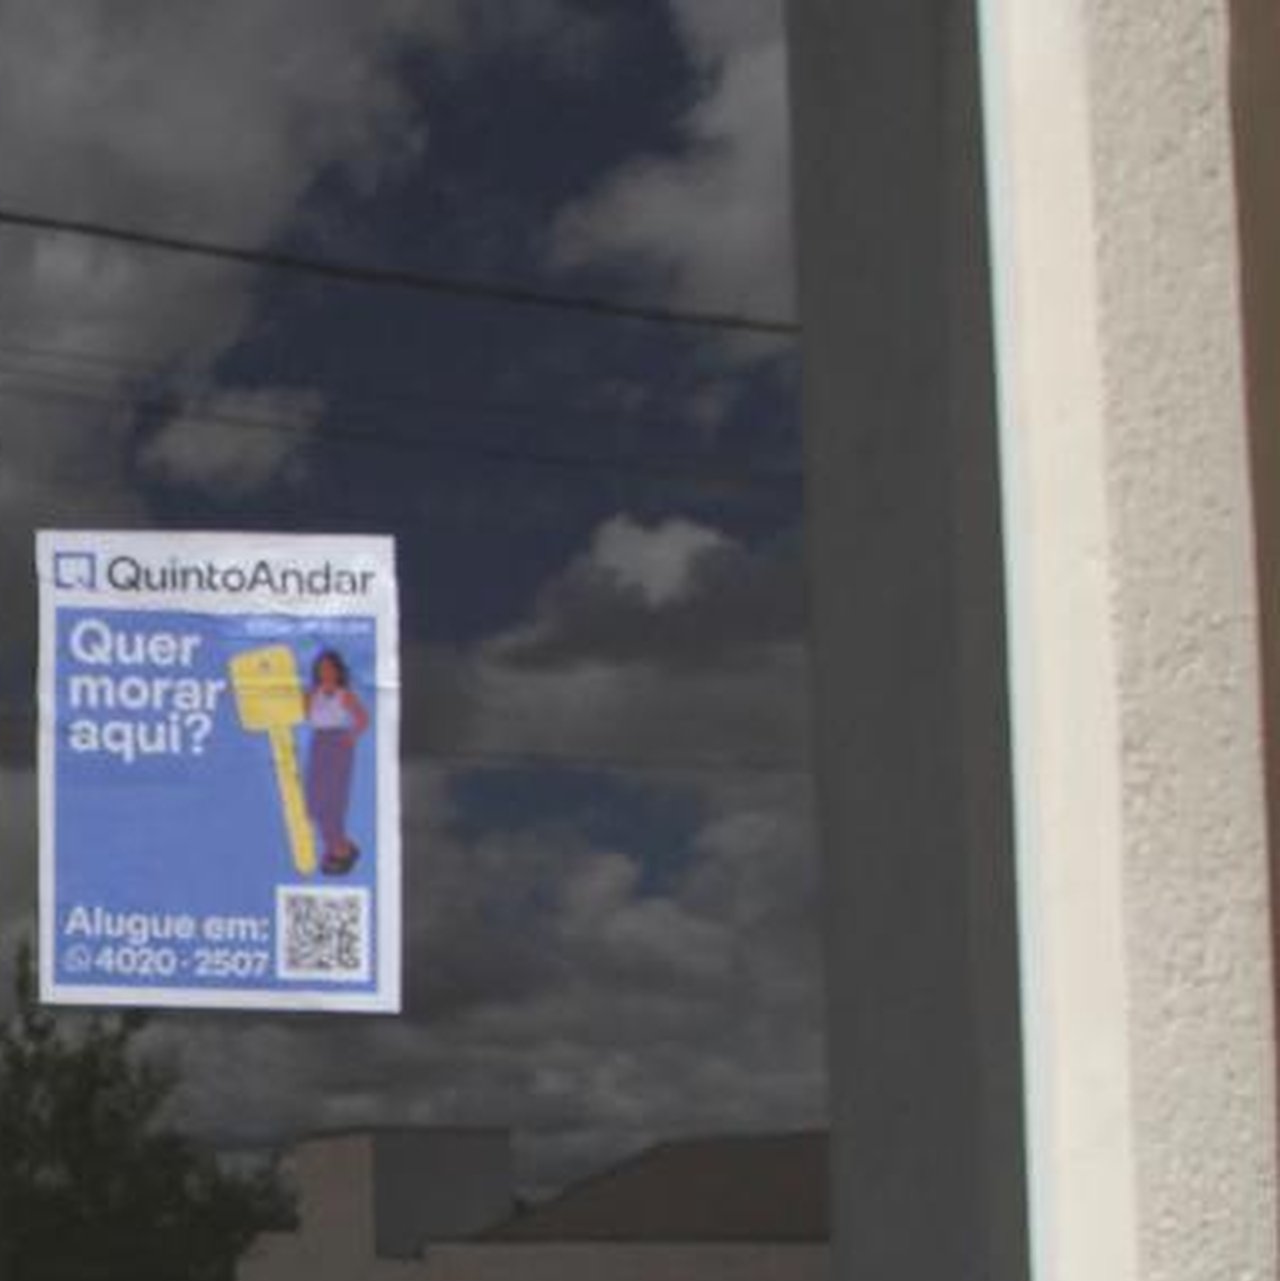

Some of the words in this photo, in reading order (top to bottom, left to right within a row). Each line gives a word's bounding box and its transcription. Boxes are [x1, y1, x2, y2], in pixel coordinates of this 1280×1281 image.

[107, 556, 375, 596] QuintoAndar
[70, 619, 201, 666] Quer
[69, 674, 227, 711] morar
[69, 714, 212, 763] aqui?
[65, 906, 195, 944] Alugue
[203, 914, 271, 942] em:
[96, 948, 177, 974] 4020
[194, 950, 270, 977] 2507
